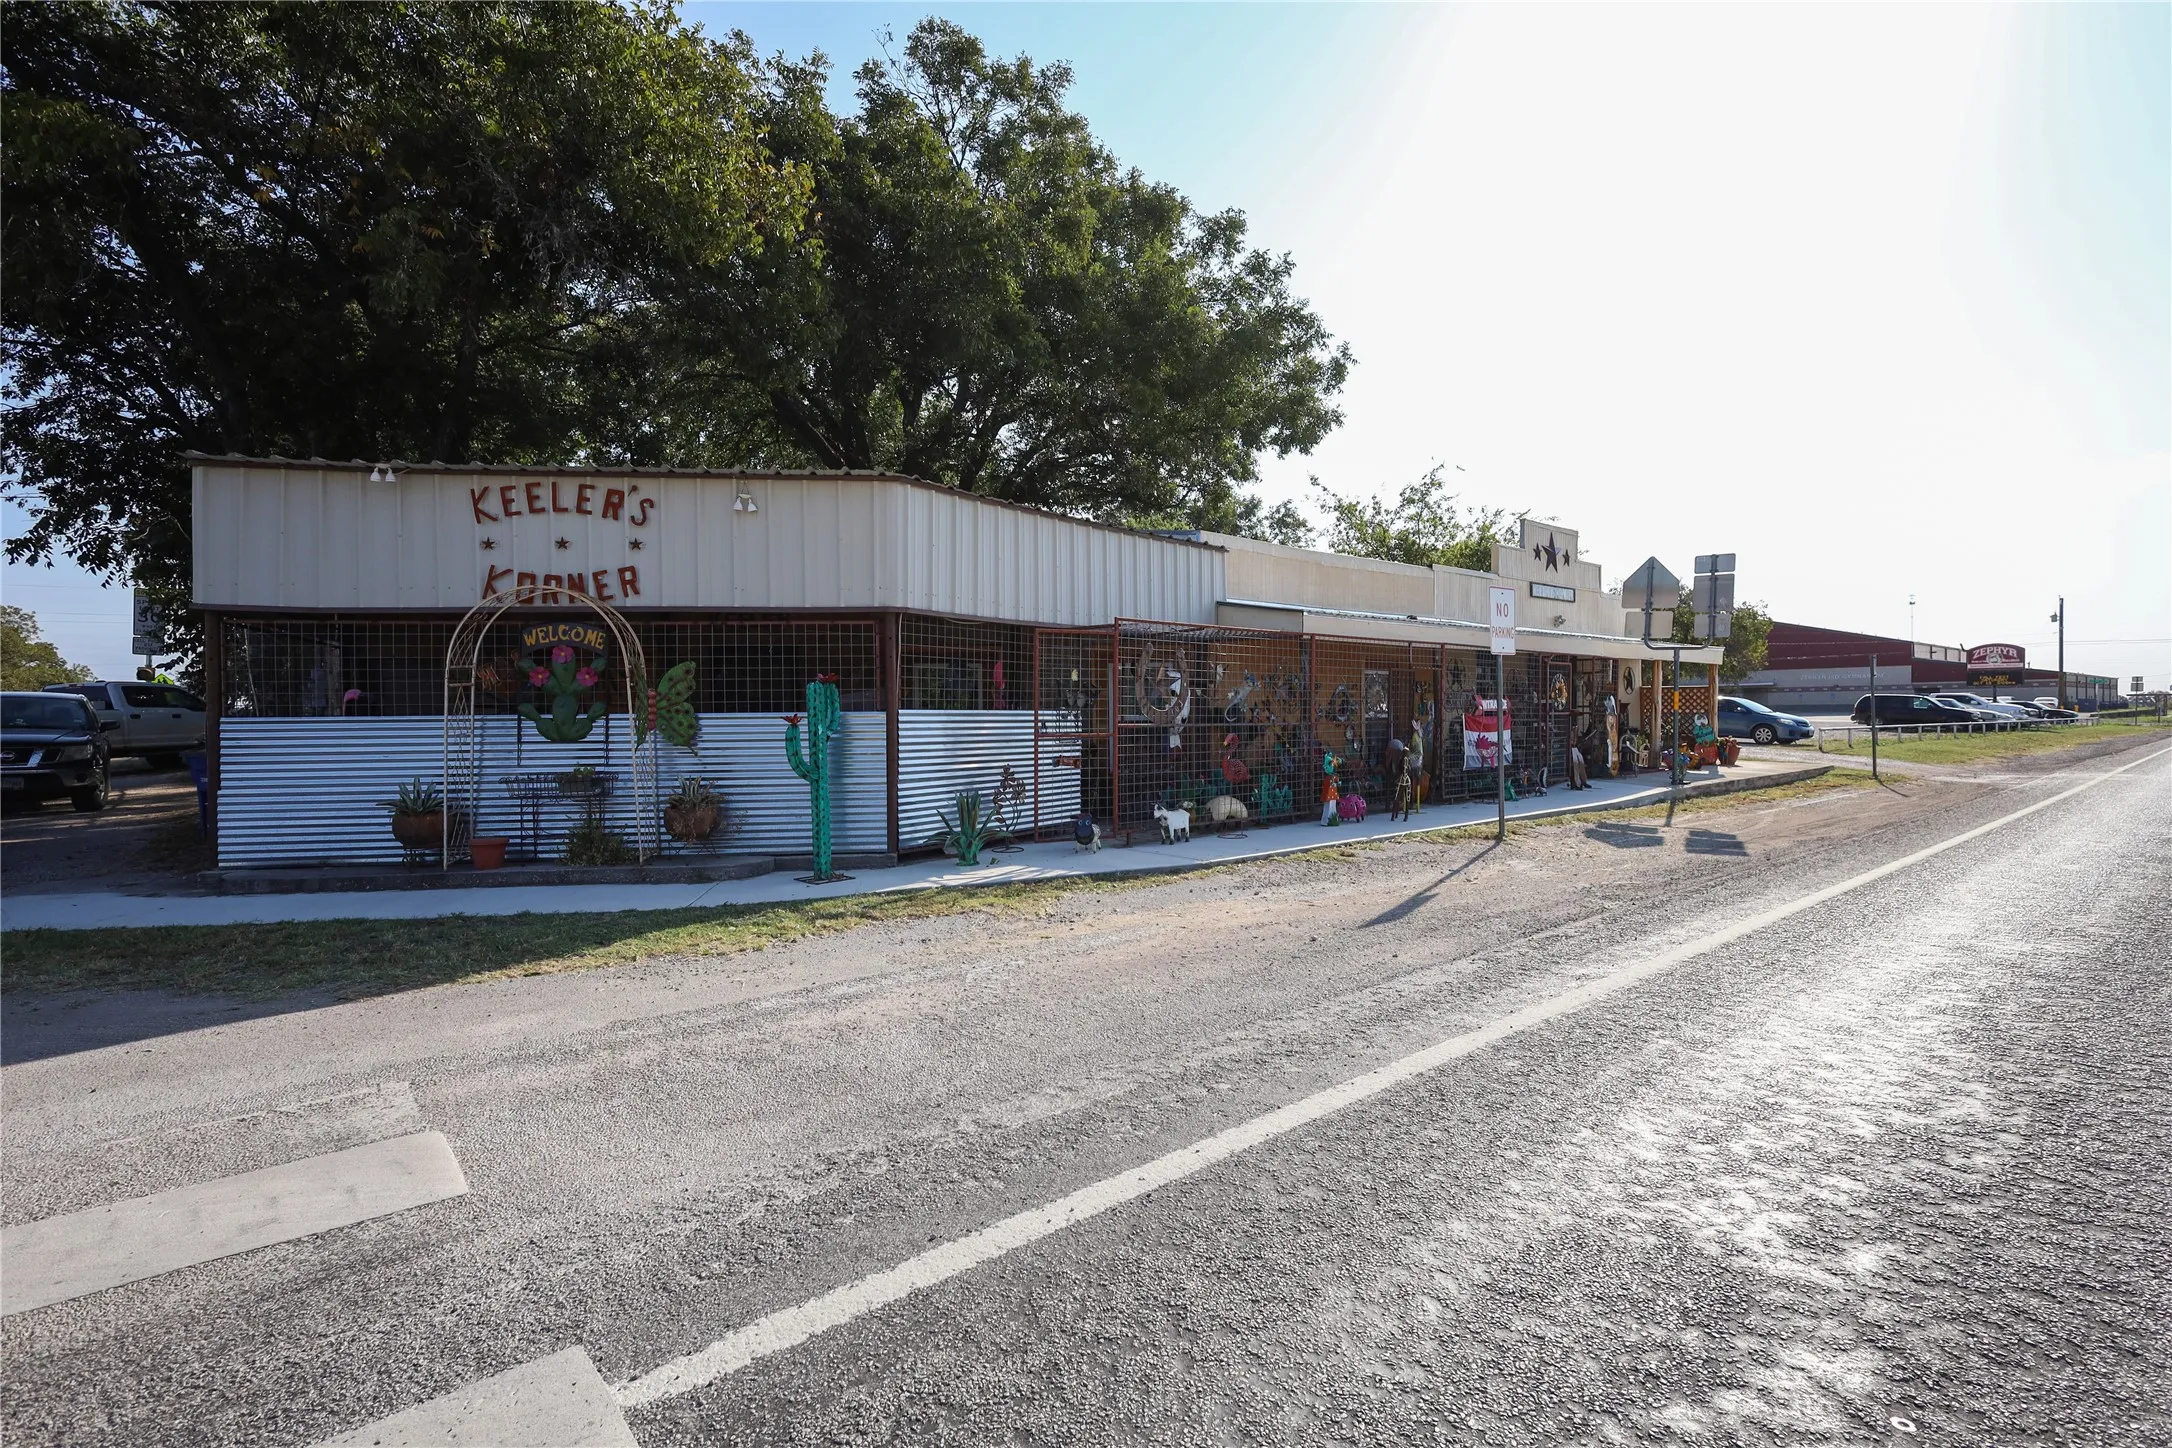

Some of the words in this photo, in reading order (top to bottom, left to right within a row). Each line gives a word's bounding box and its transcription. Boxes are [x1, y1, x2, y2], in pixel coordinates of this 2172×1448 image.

[470, 482, 655, 526] KEELER'S
[482, 564, 640, 605] KORNER
[1496, 602, 1509, 618] NO
[522, 624, 607, 650] WELCOME
[1491, 626, 1515, 639] PARKING
[1972, 646, 2018, 660] ZEPHYR
